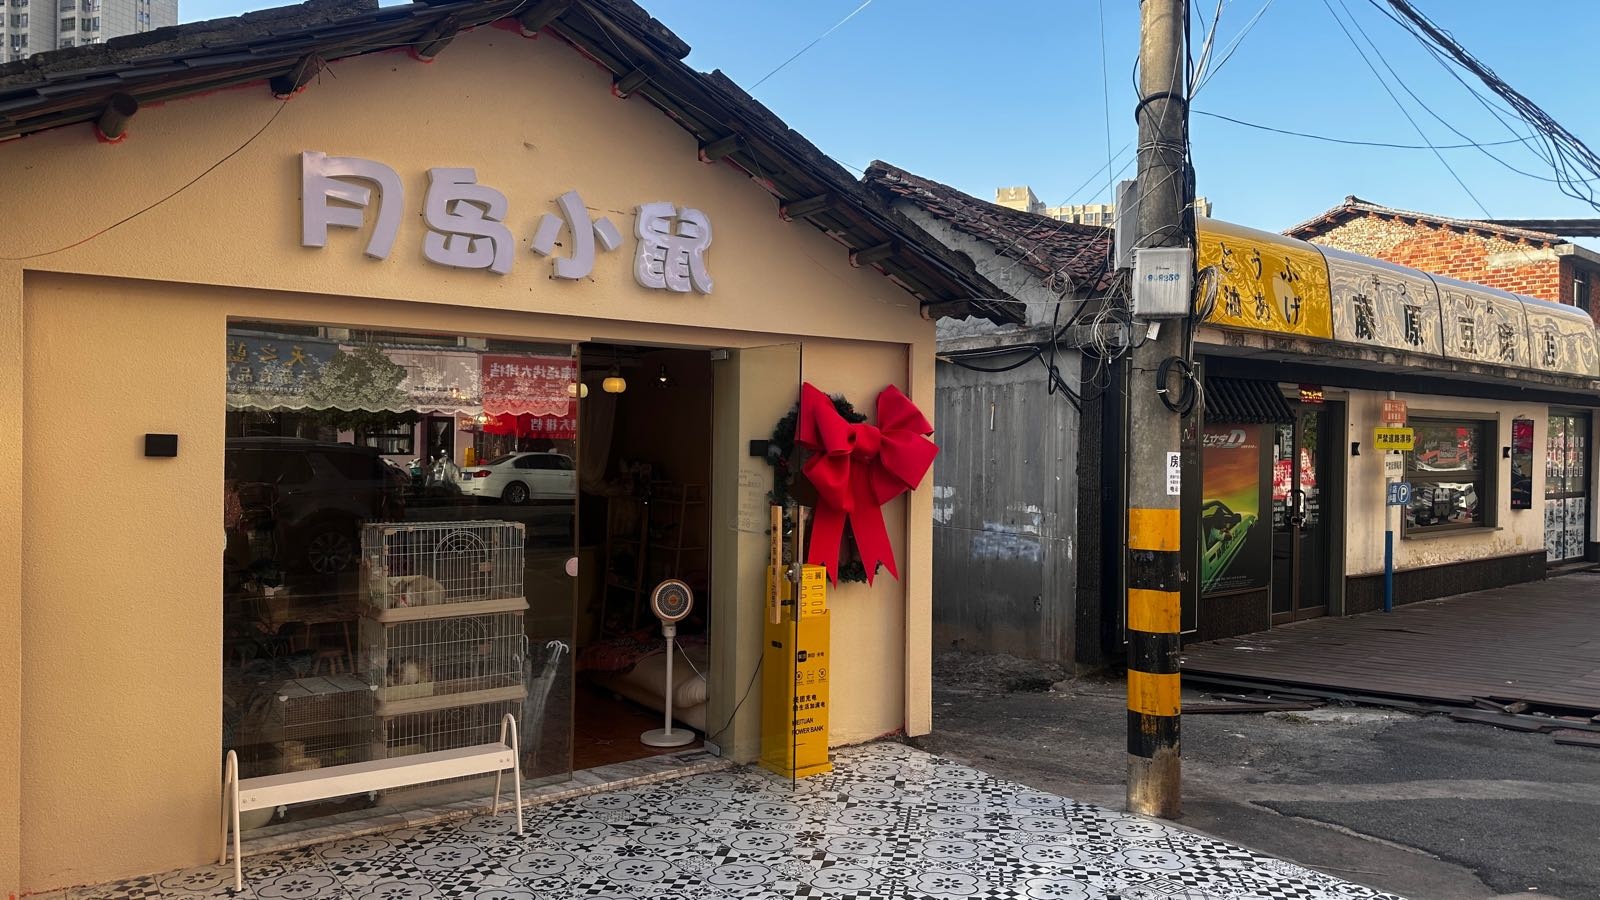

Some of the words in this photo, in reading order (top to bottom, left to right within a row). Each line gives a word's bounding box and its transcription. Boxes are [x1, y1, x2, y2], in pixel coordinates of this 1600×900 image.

[301, 151, 714, 294] 月岛小鼠
[1220, 242, 1299, 283] とうふ
[1224, 285, 1302, 325] 油あげ
[1376, 433, 1412, 444] 严禁道路漂移
[1170, 455, 1180, 468] 房
[810, 725, 824, 733] BANK
